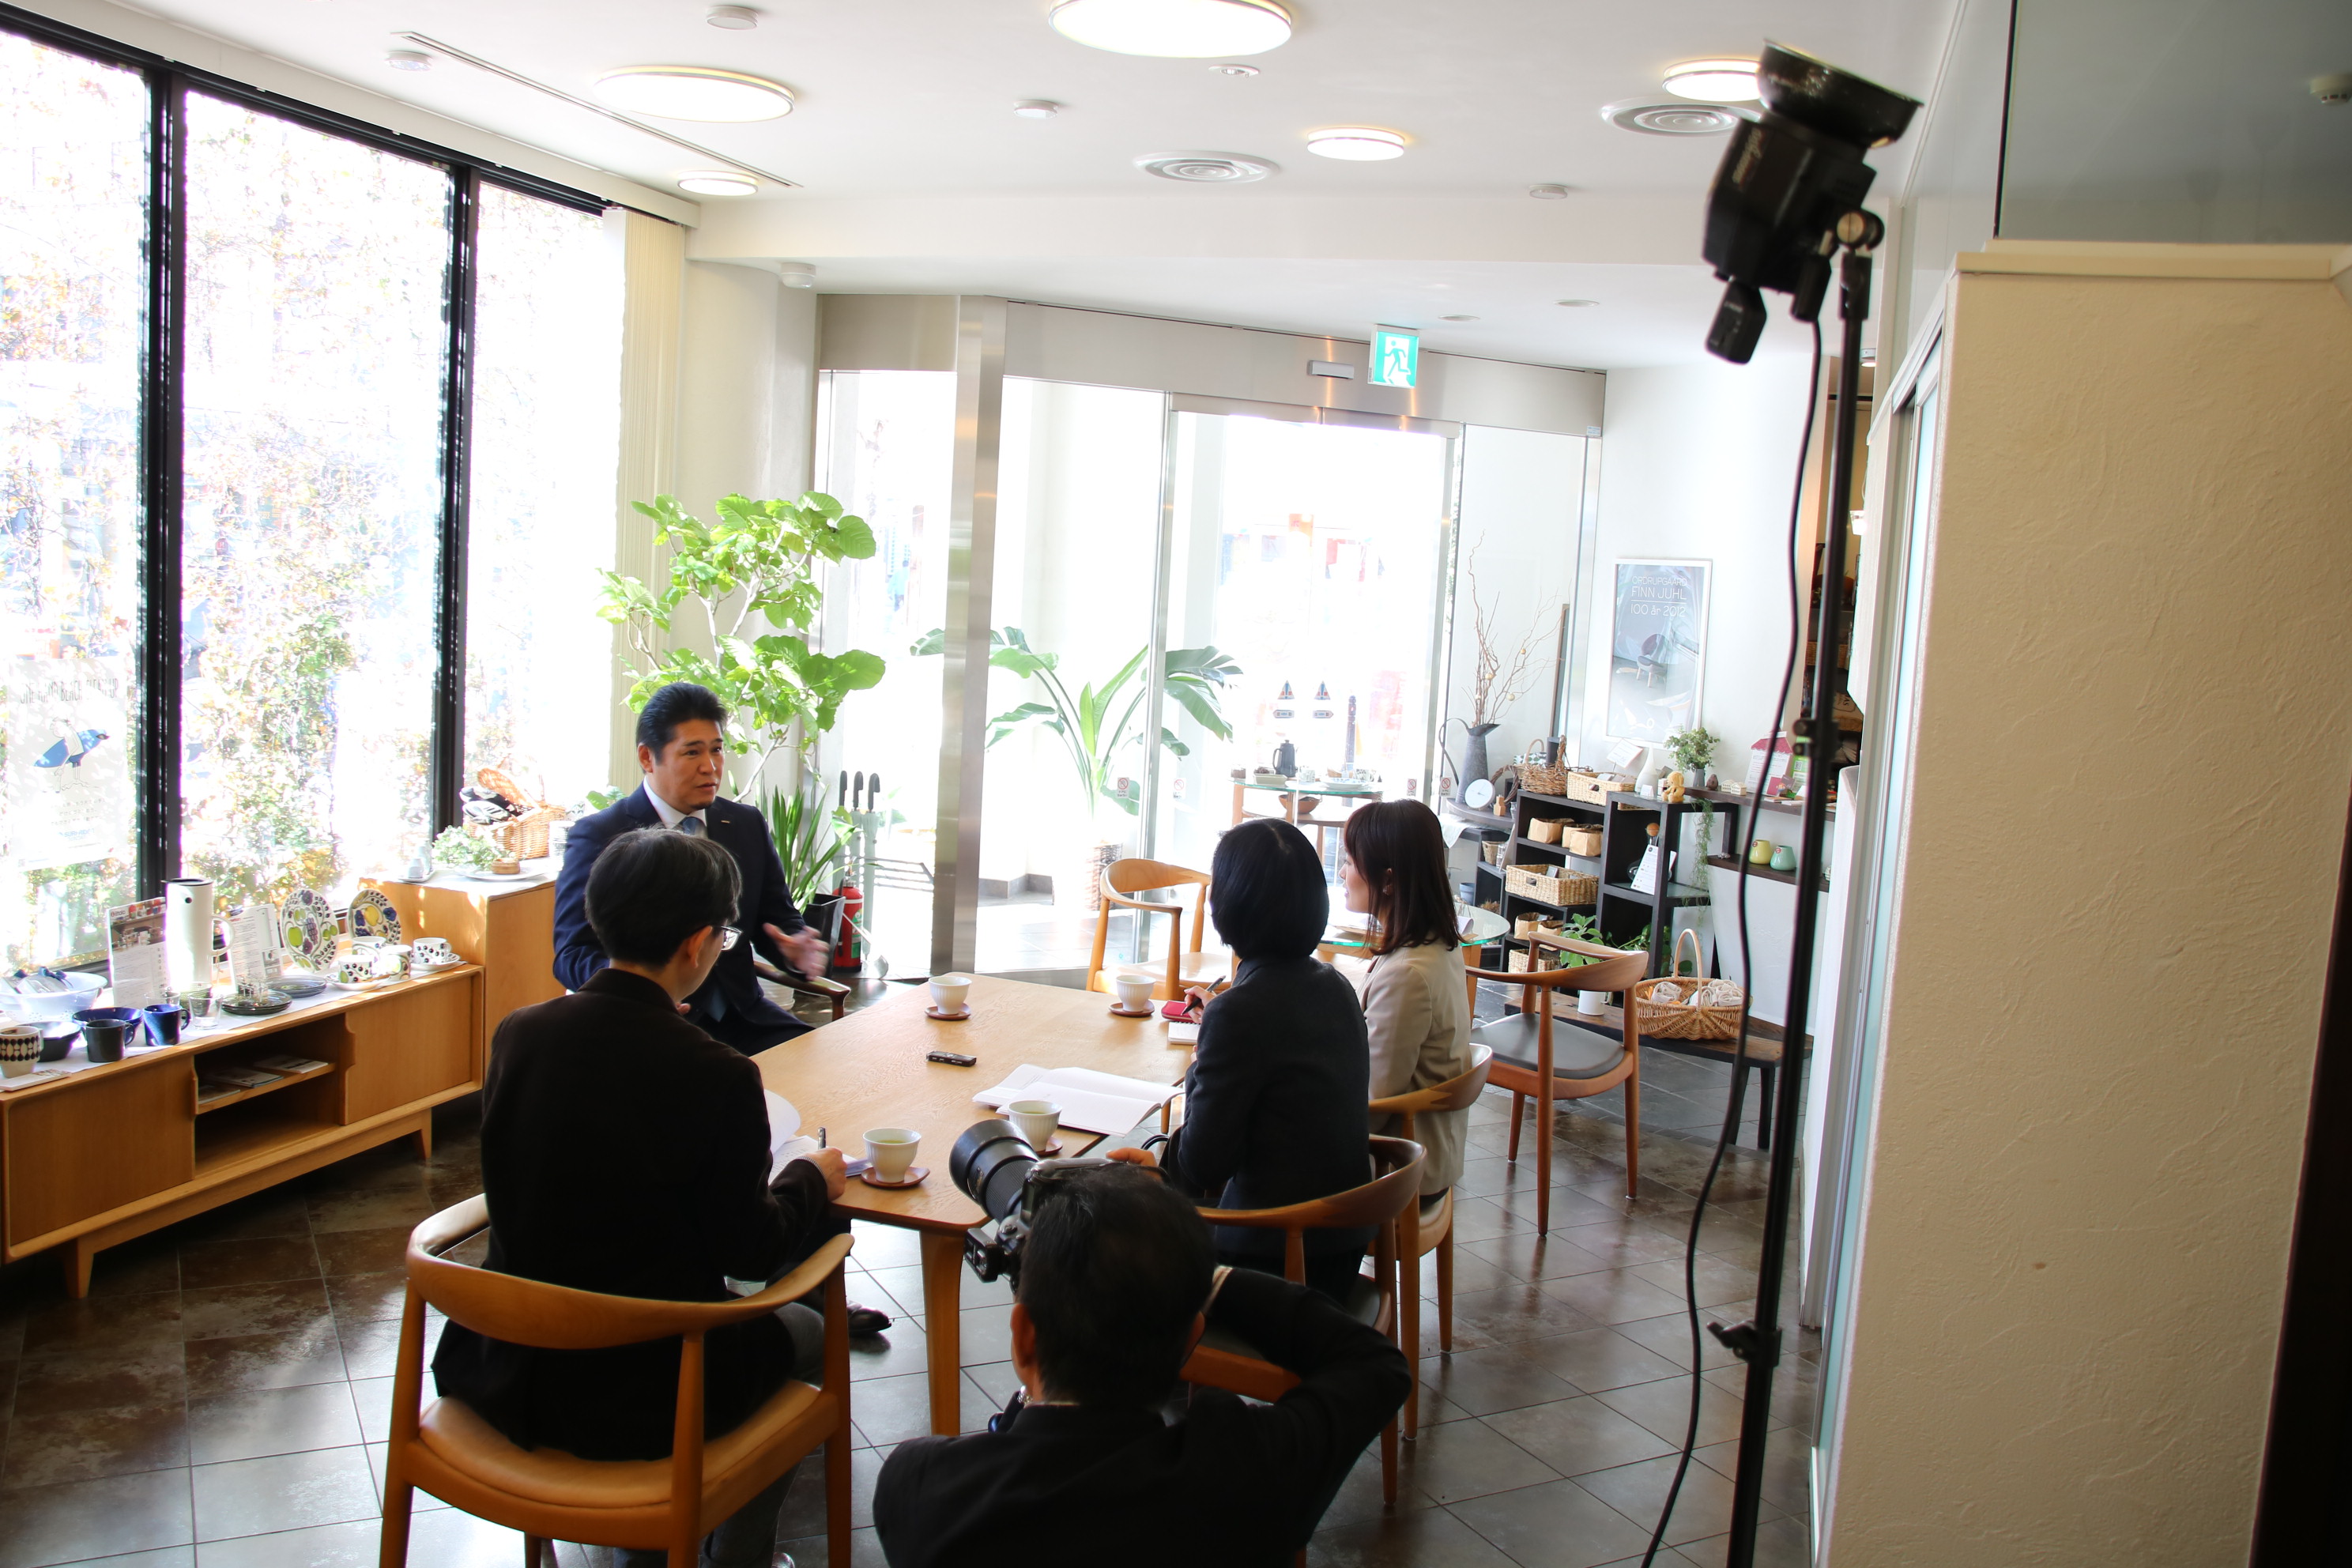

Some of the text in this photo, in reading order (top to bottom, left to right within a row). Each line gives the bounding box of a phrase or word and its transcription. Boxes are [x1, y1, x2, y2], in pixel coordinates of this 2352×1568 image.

[1632, 575, 1687, 586] ORDRUPGAARD
[1631, 586, 1687, 600] FINN JUHL
[1630, 603, 1687, 617] 100 år 2012
